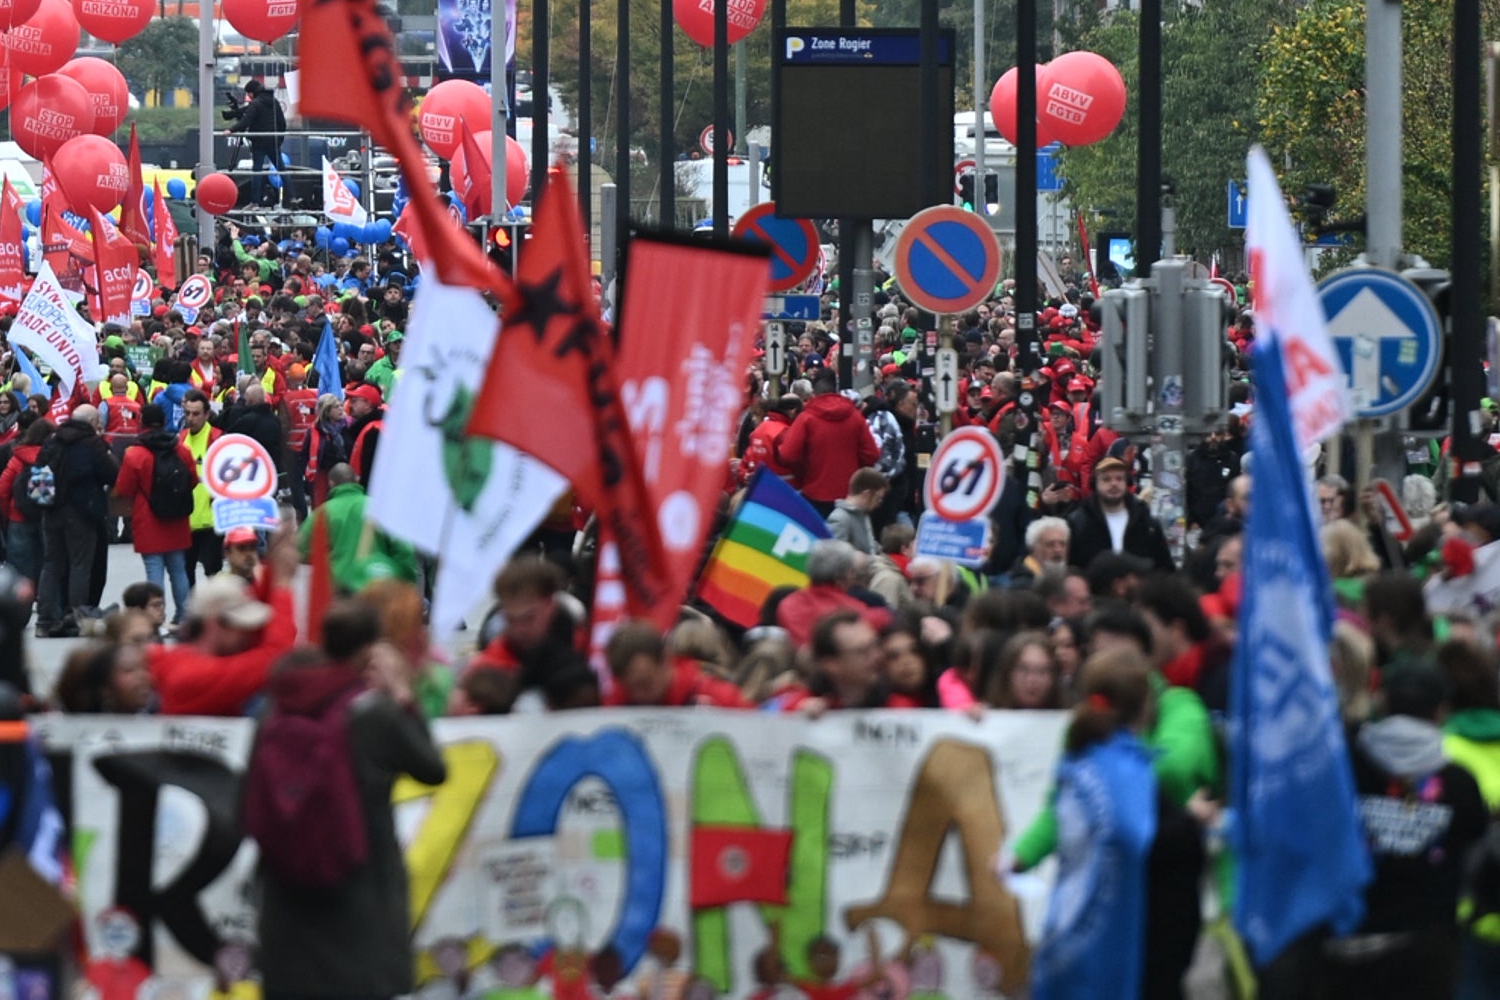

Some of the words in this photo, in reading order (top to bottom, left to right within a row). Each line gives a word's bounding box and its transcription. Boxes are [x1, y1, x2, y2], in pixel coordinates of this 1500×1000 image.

[83, 3, 137, 17] ARIZONA
[702, 0, 757, 28] AZONA
[1, 34, 50, 55] ARIZONA
[811, 37, 836, 50] Zone
[839, 37, 872, 53] Rogier
[1051, 85, 1088, 106] ABVV
[39, 110, 74, 127] STOP
[1047, 102, 1082, 121] FGTB
[218, 457, 259, 482] 67
[941, 458, 984, 496] 67
